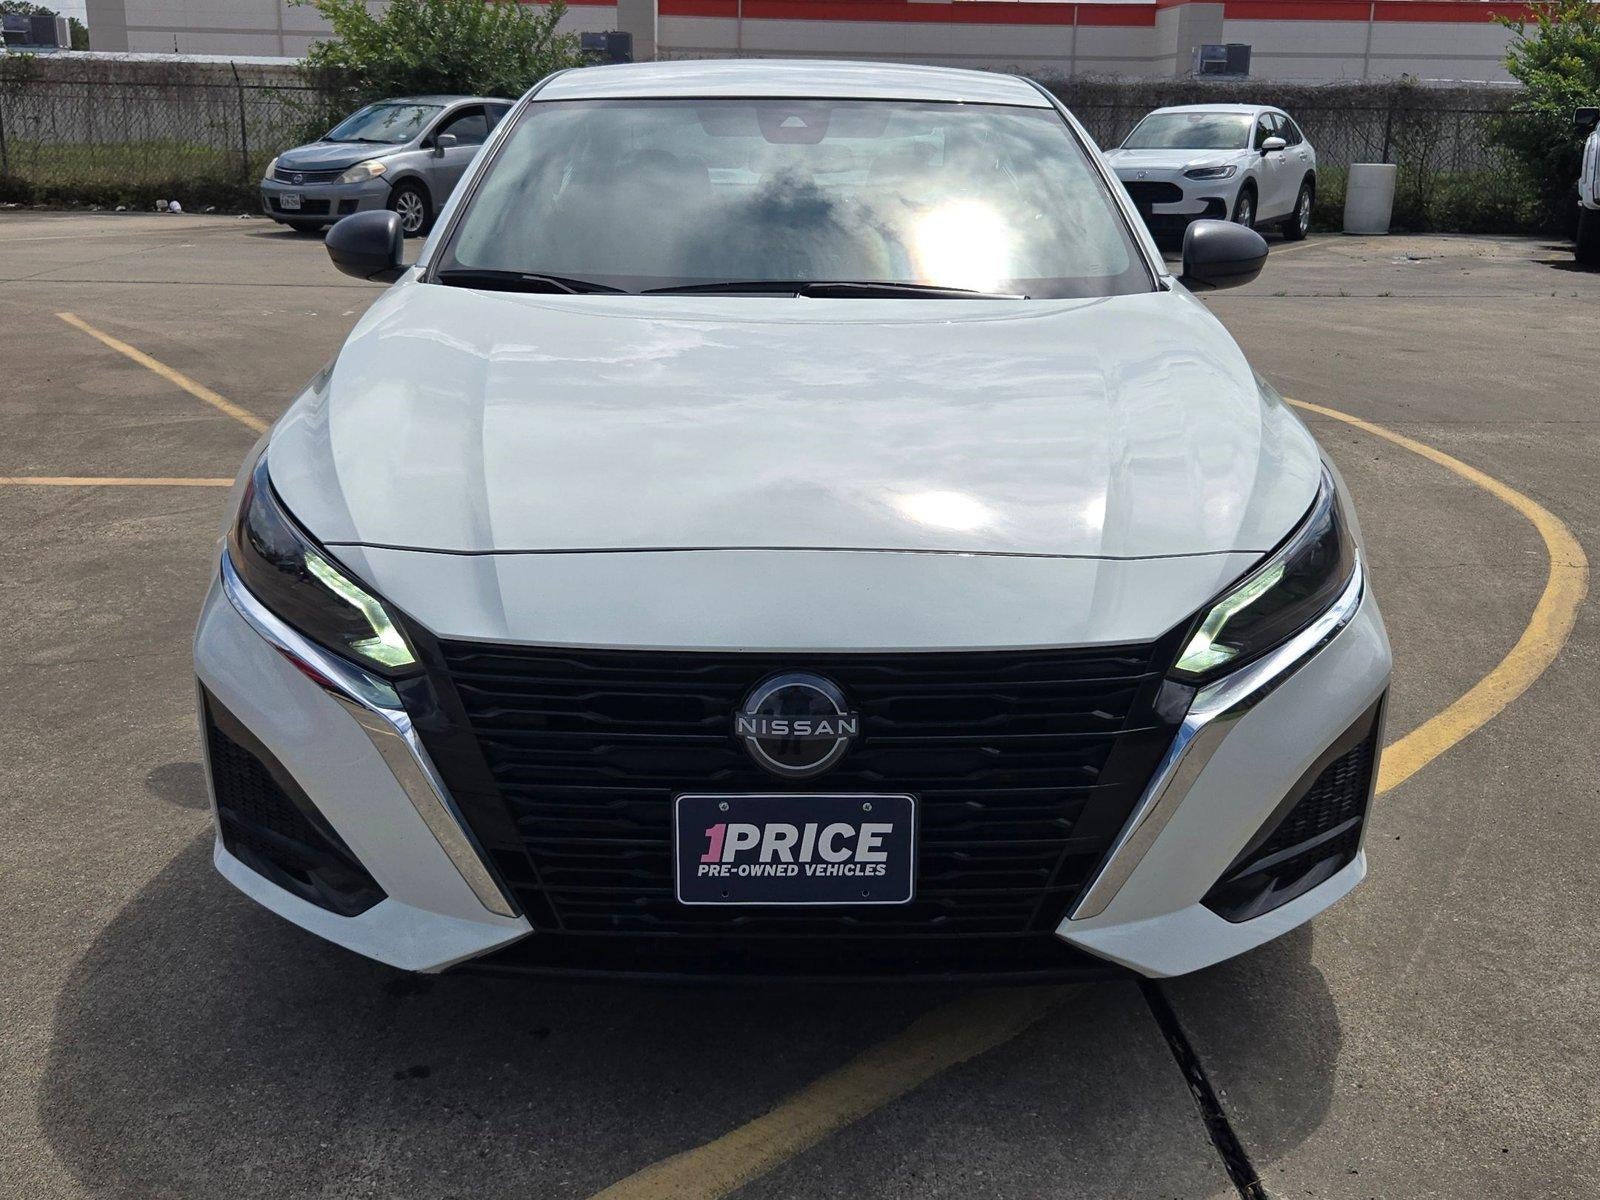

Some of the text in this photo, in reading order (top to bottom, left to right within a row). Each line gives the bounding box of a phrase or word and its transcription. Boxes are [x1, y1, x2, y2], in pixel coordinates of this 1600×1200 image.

[737, 718, 857, 736] NISSAN
[697, 863, 887, 877] PRE-OWNED VEHICLES
